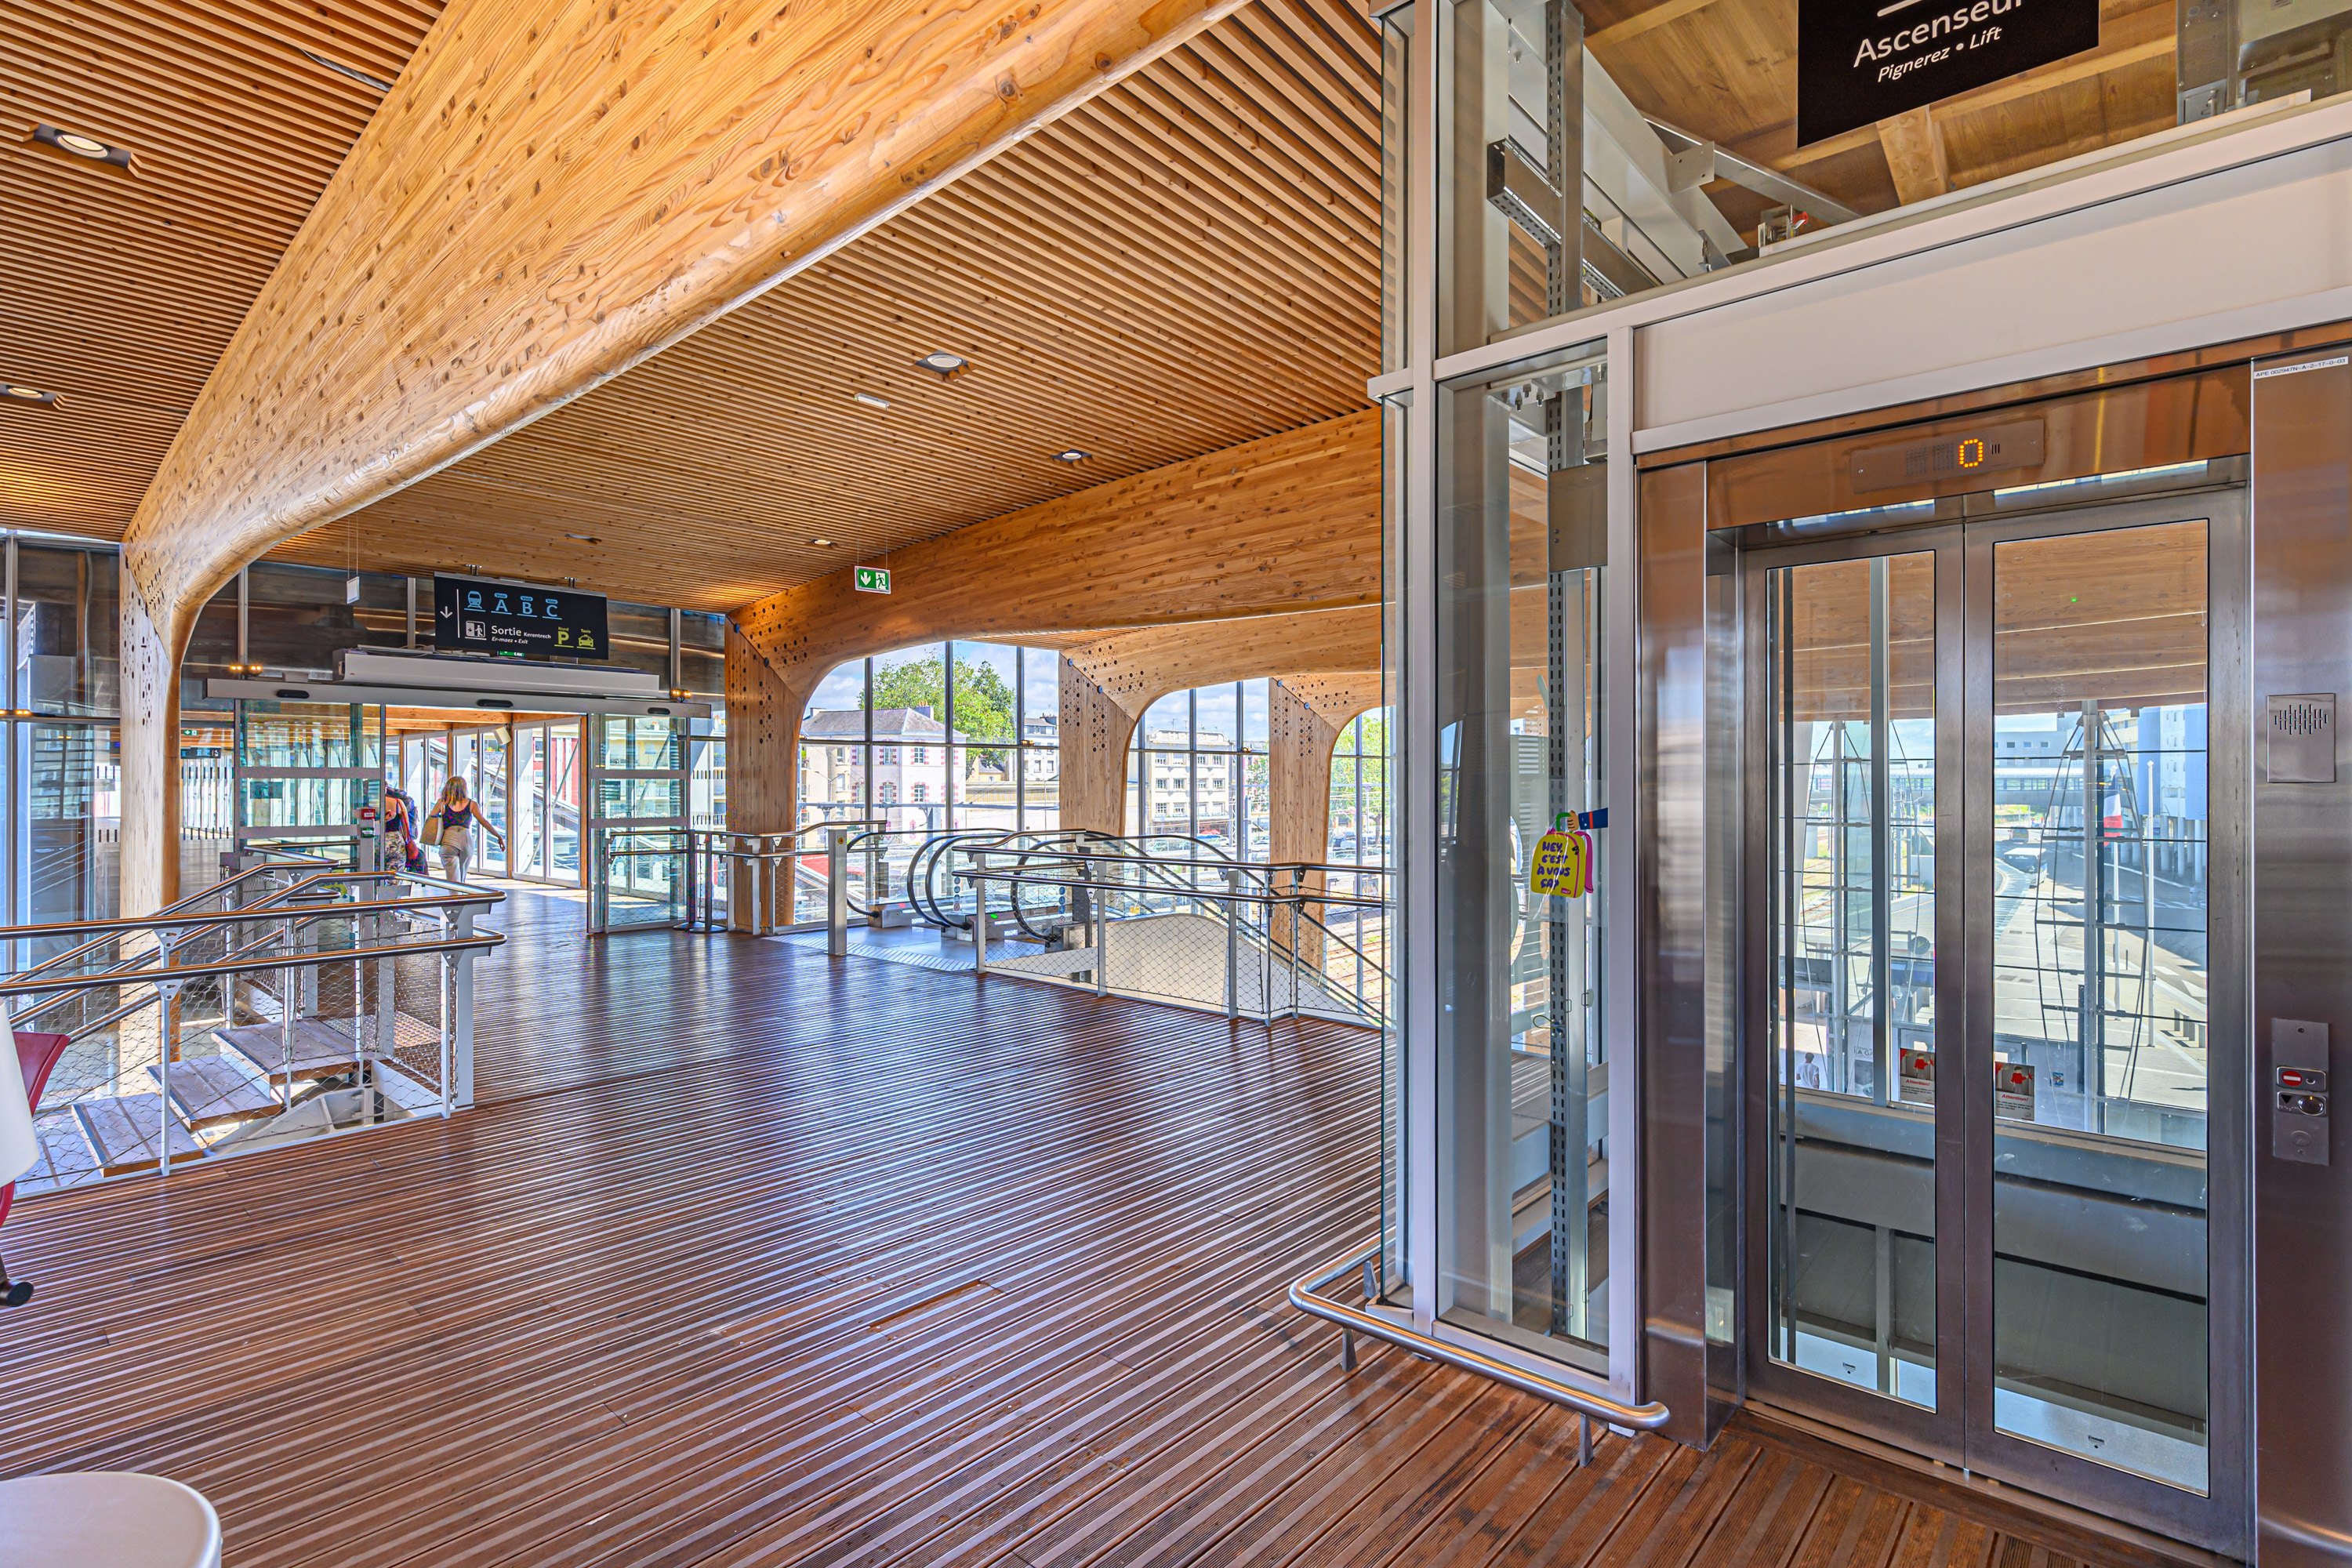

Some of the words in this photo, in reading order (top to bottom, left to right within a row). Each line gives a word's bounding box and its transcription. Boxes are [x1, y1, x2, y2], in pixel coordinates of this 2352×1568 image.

[1878, 47, 1951, 82] Pignerez
[1969, 27, 2002, 49] Lift
[1959, 438, 1984, 468] 0
[495, 599, 508, 612] A
[522, 601, 533, 615] B
[546, 604, 558, 618] C
[491, 626, 521, 637] Sortie
[557, 632, 569, 644] P
[1542, 841, 1563, 853] HEY,
[1541, 855, 1568, 864] C'EST
[1537, 863, 1544, 876] À
[1547, 867, 1570, 877] VOUS
